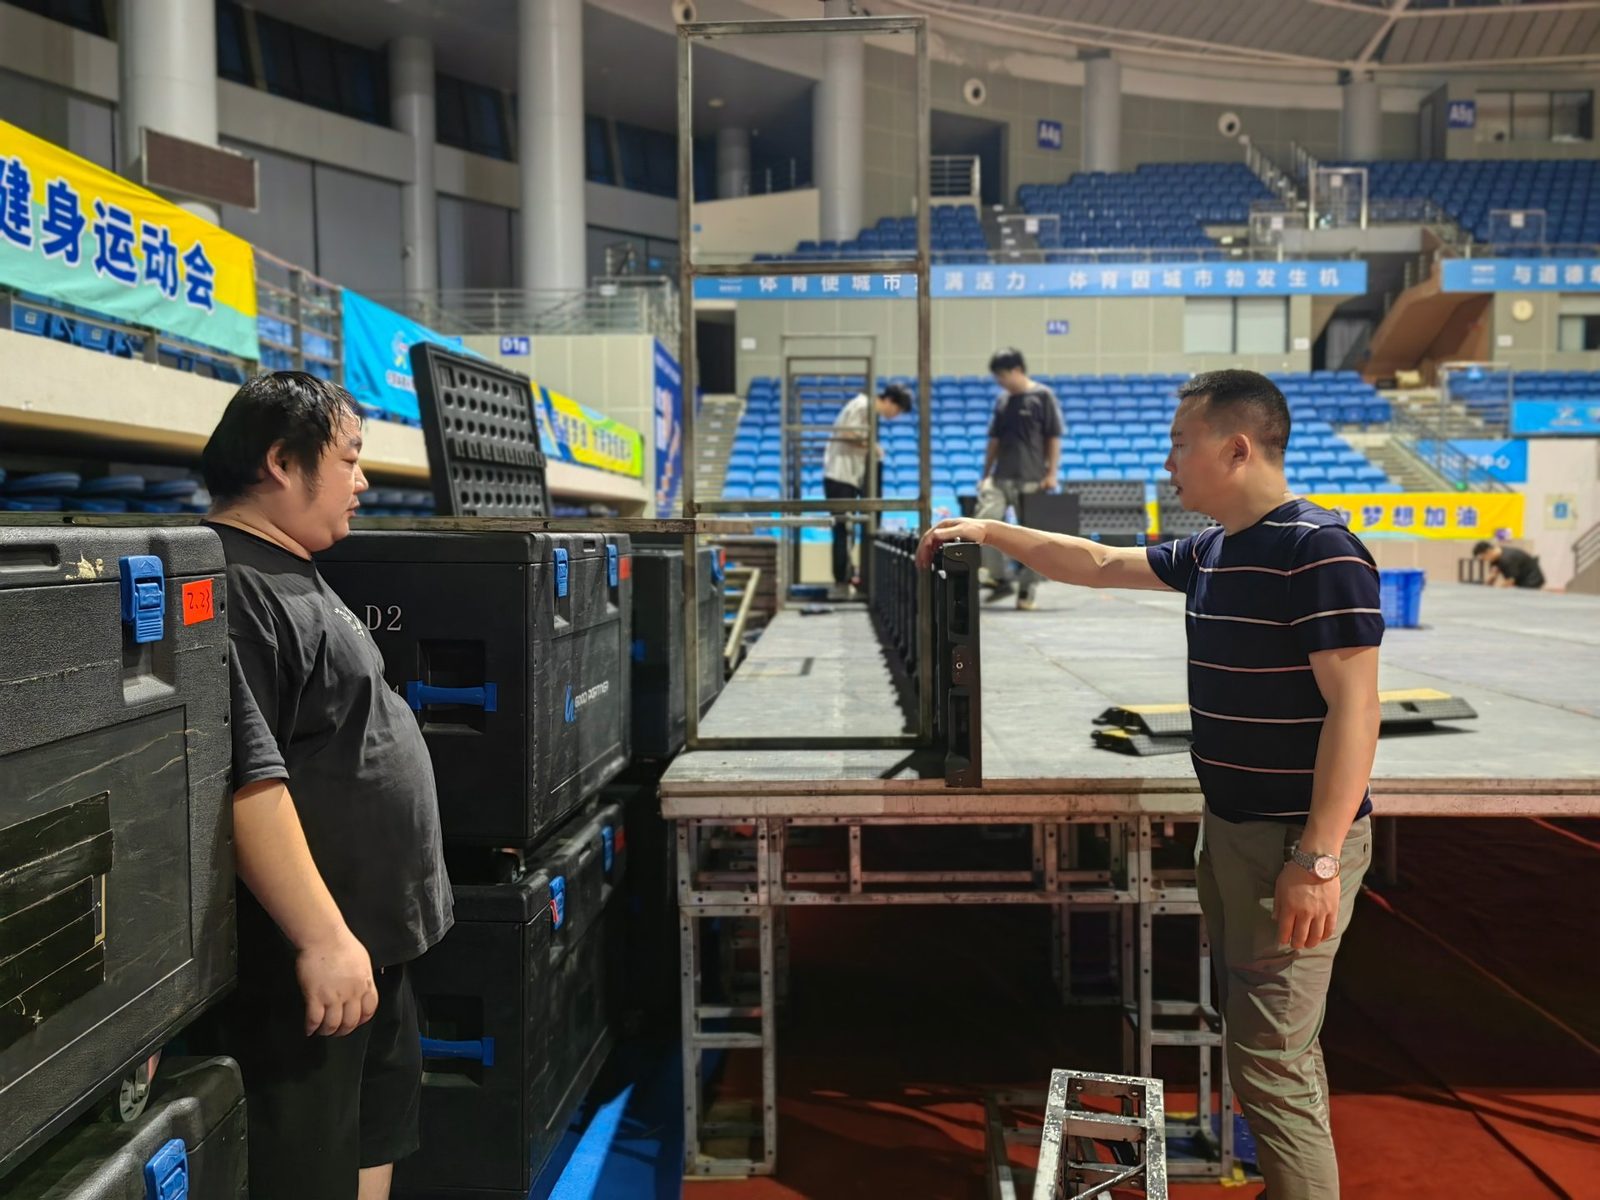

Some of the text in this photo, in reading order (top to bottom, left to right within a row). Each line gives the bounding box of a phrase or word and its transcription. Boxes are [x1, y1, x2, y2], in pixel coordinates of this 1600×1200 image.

[0, 157, 215, 313] 健身运动会
[365, 605, 402, 631] D2
